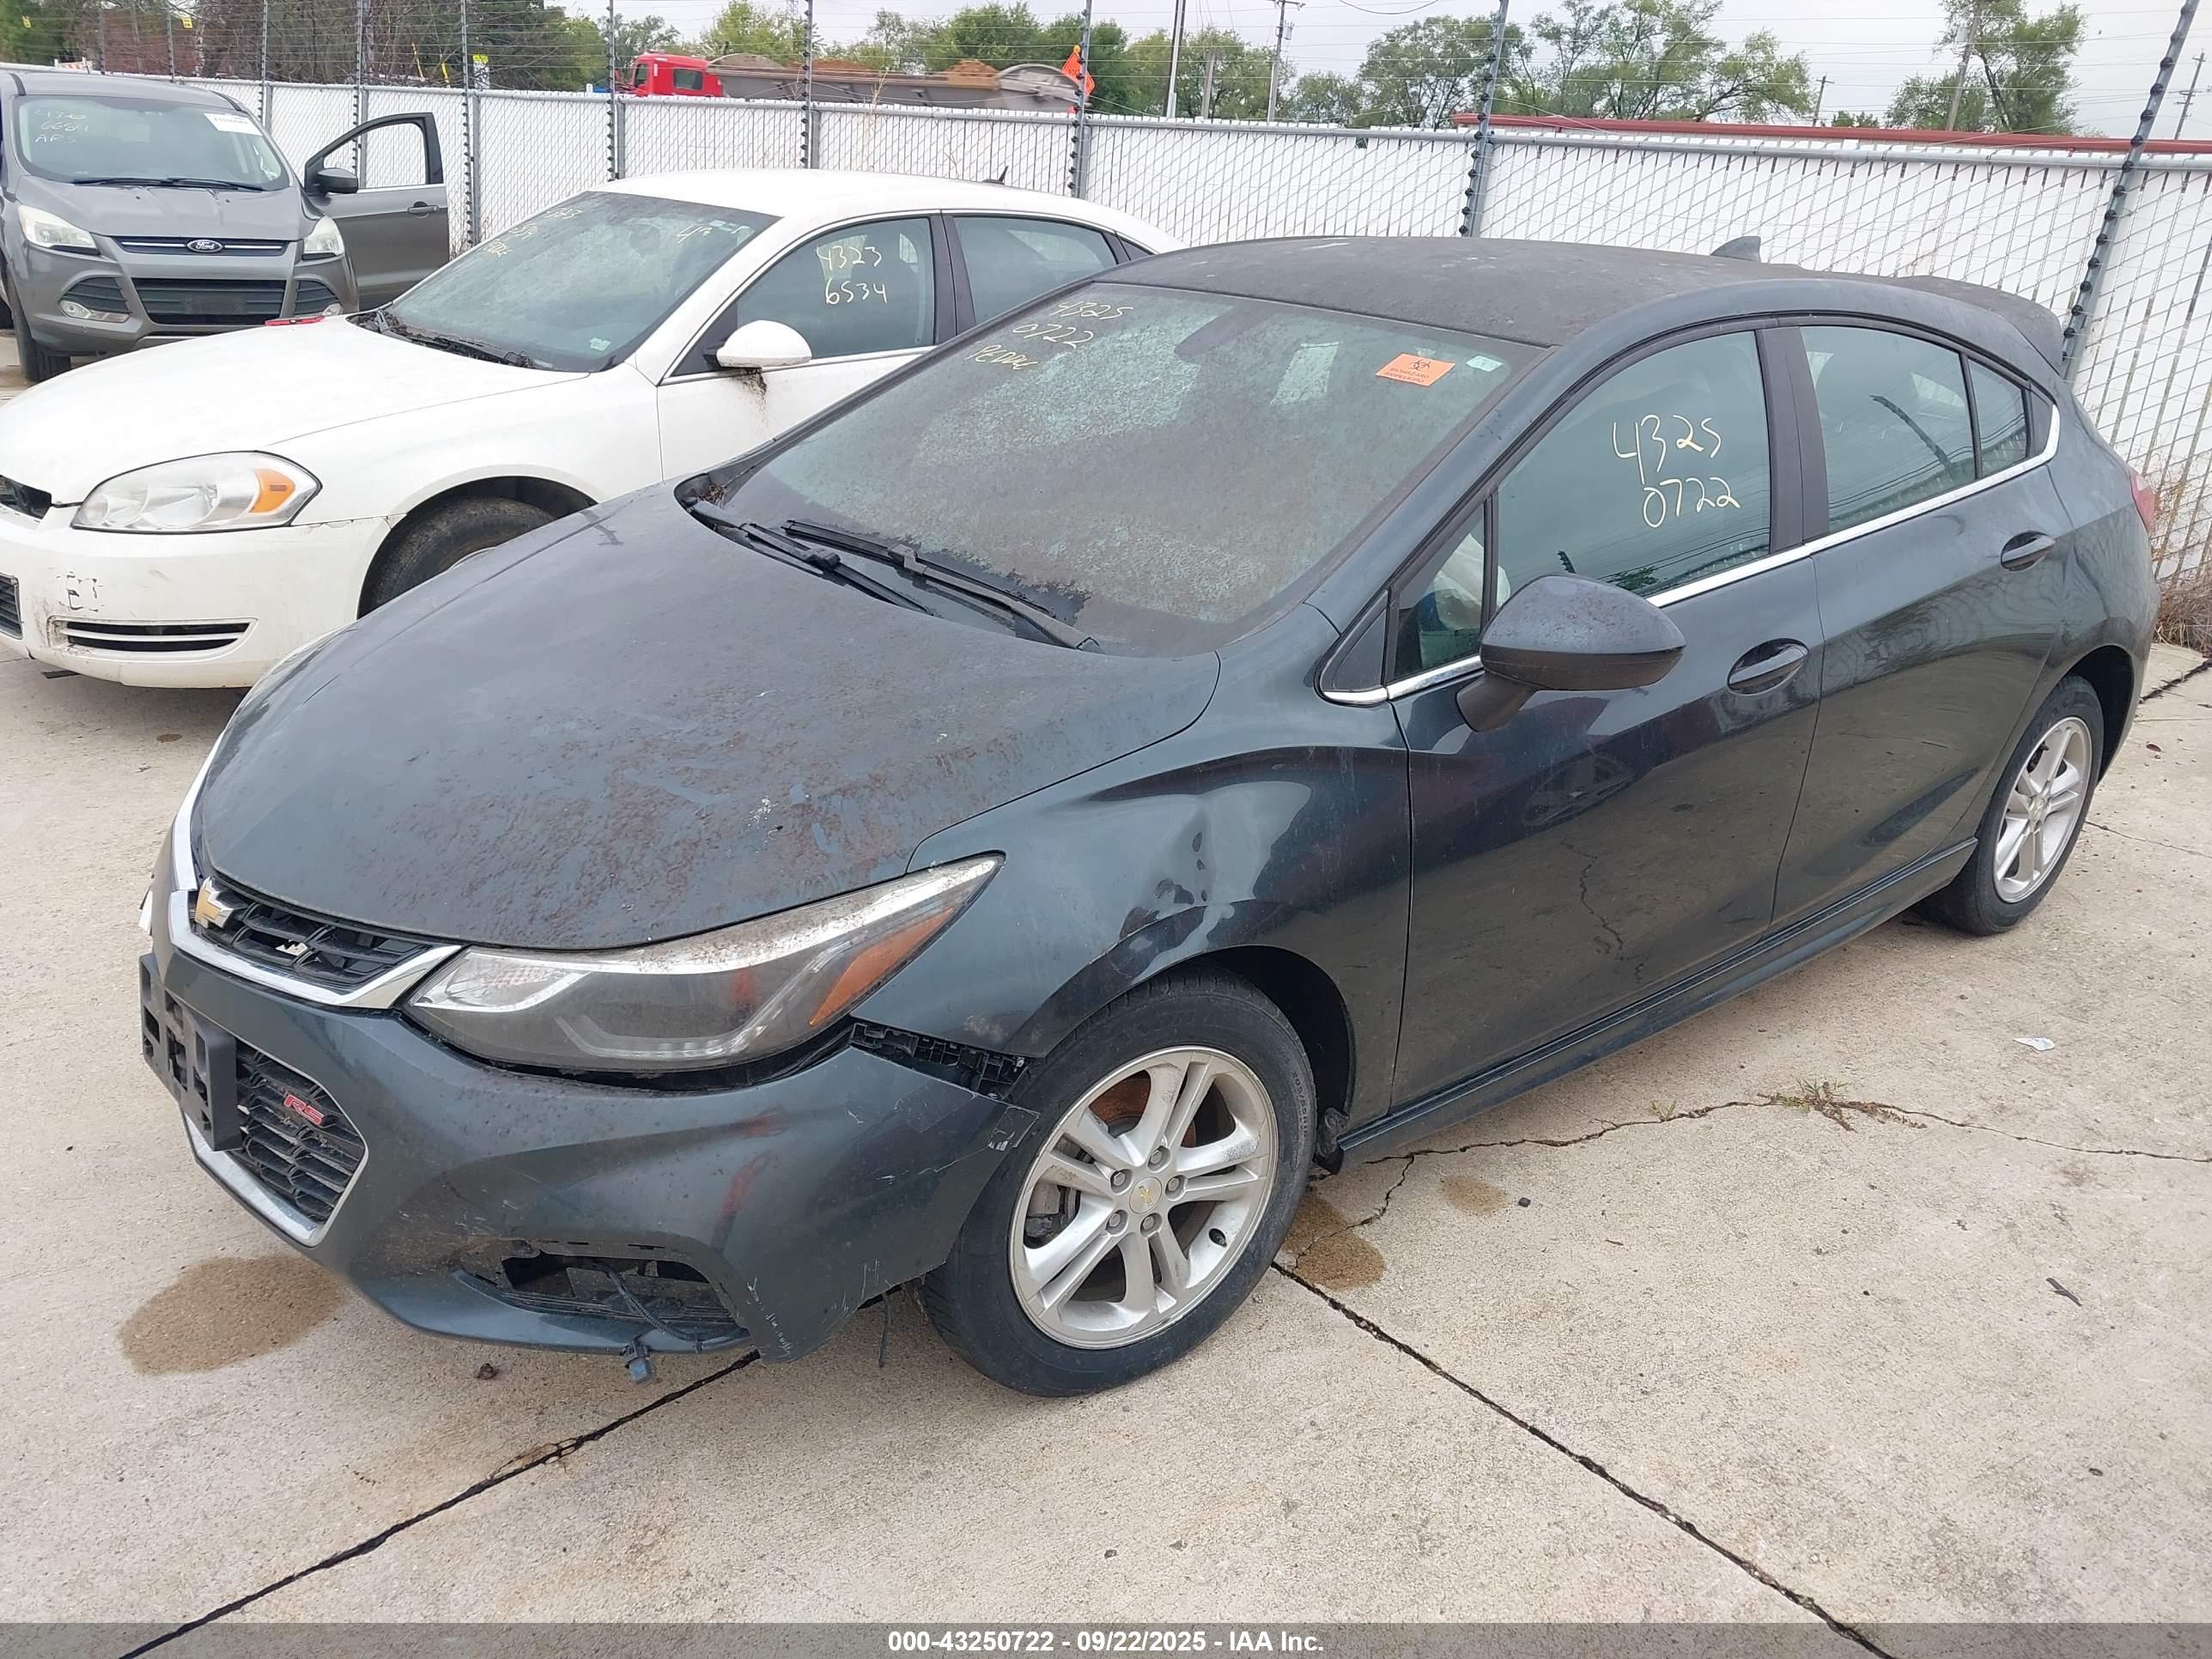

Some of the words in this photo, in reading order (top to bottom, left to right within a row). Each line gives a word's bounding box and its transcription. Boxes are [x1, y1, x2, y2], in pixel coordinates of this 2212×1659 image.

[816, 245, 882, 270] 4323
[825, 277, 888, 305] 6534
[1048, 301, 1134, 320] 4325
[1012, 324, 1094, 349] 0722
[1612, 414, 1722, 485] 4325
[1643, 477, 1741, 528] 0722
[283, 1094, 325, 1126] RS
